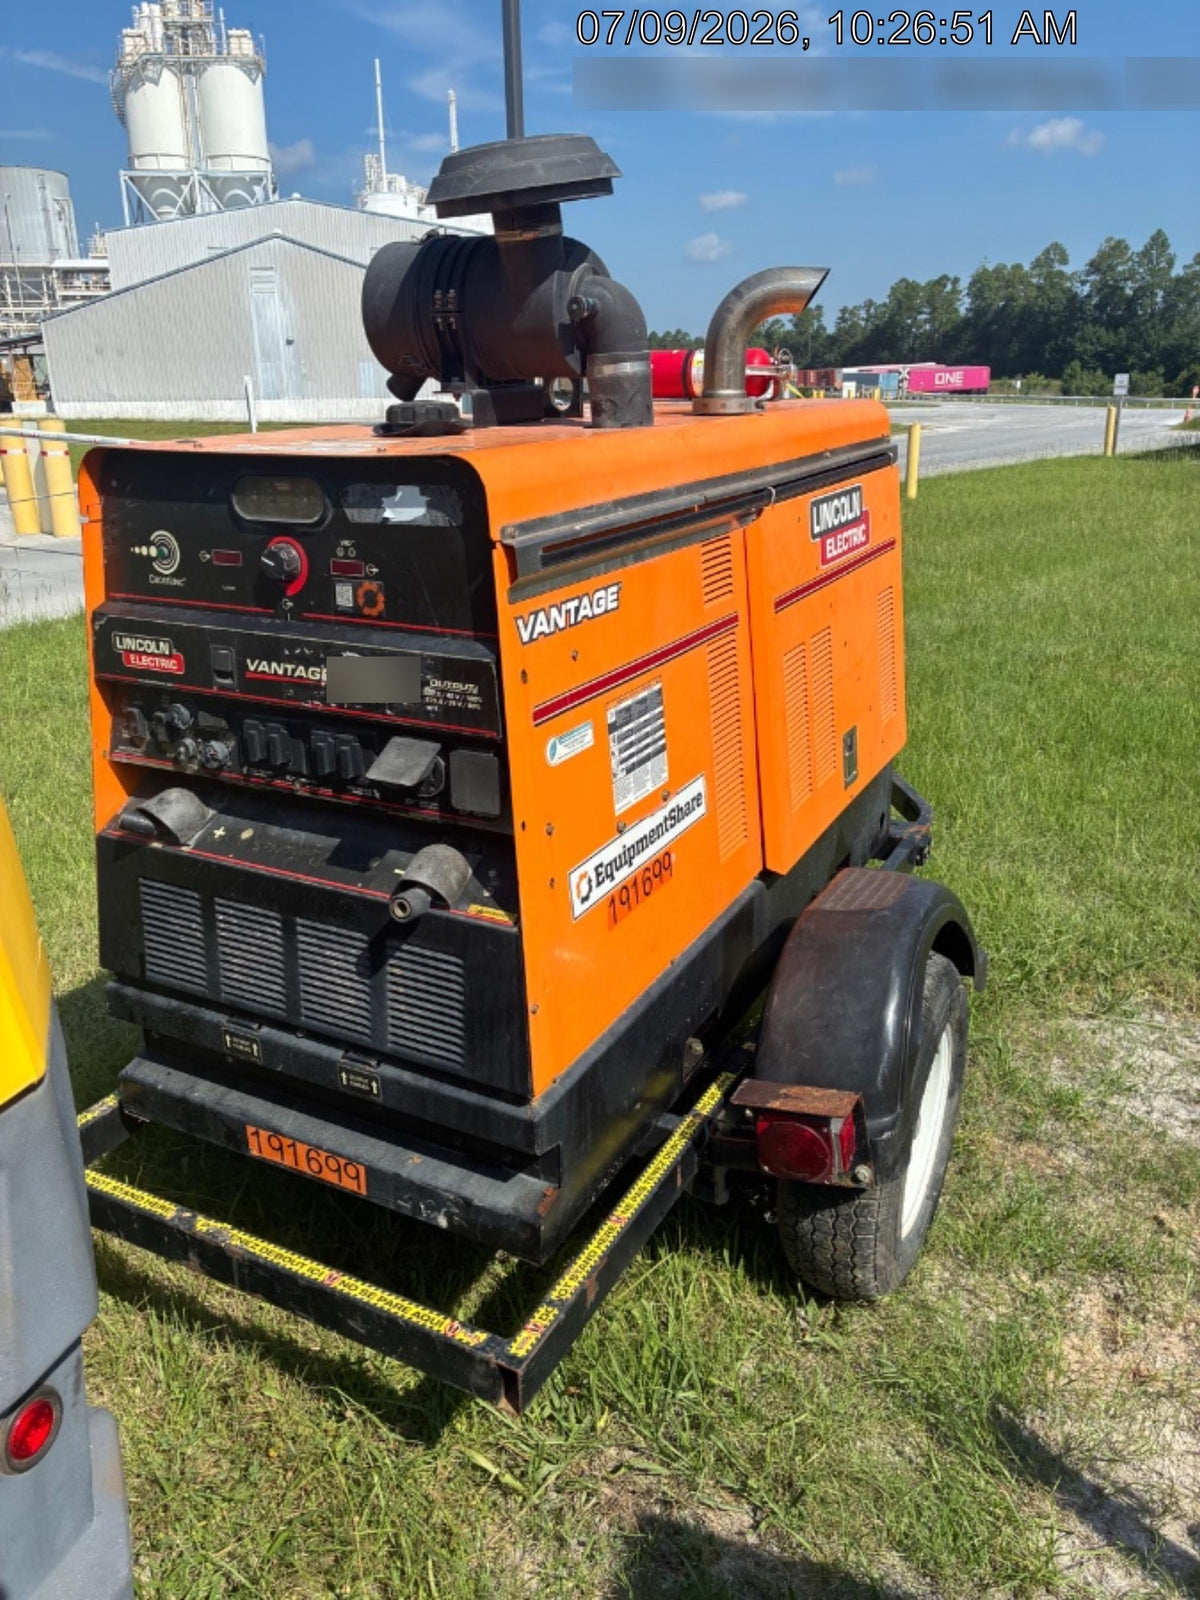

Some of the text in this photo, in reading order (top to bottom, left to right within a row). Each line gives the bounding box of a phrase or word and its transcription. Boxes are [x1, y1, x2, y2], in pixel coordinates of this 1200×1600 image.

[935, 371, 964, 385] ONE
[813, 491, 861, 534] LINCOLN
[826, 523, 867, 559] ELECTRIC
[515, 581, 621, 644] VANTAGE
[115, 636, 170, 655] LINCOLN
[129, 653, 178, 670] ELECTRIC
[594, 792, 703, 888] EquipmentShare
[608, 851, 673, 924] 191699
[251, 1129, 362, 1192] 191699
[339, 1279, 358, 1292] NO
[359, 1287, 375, 1300] SE
[376, 1295, 412, 1314] PARE
